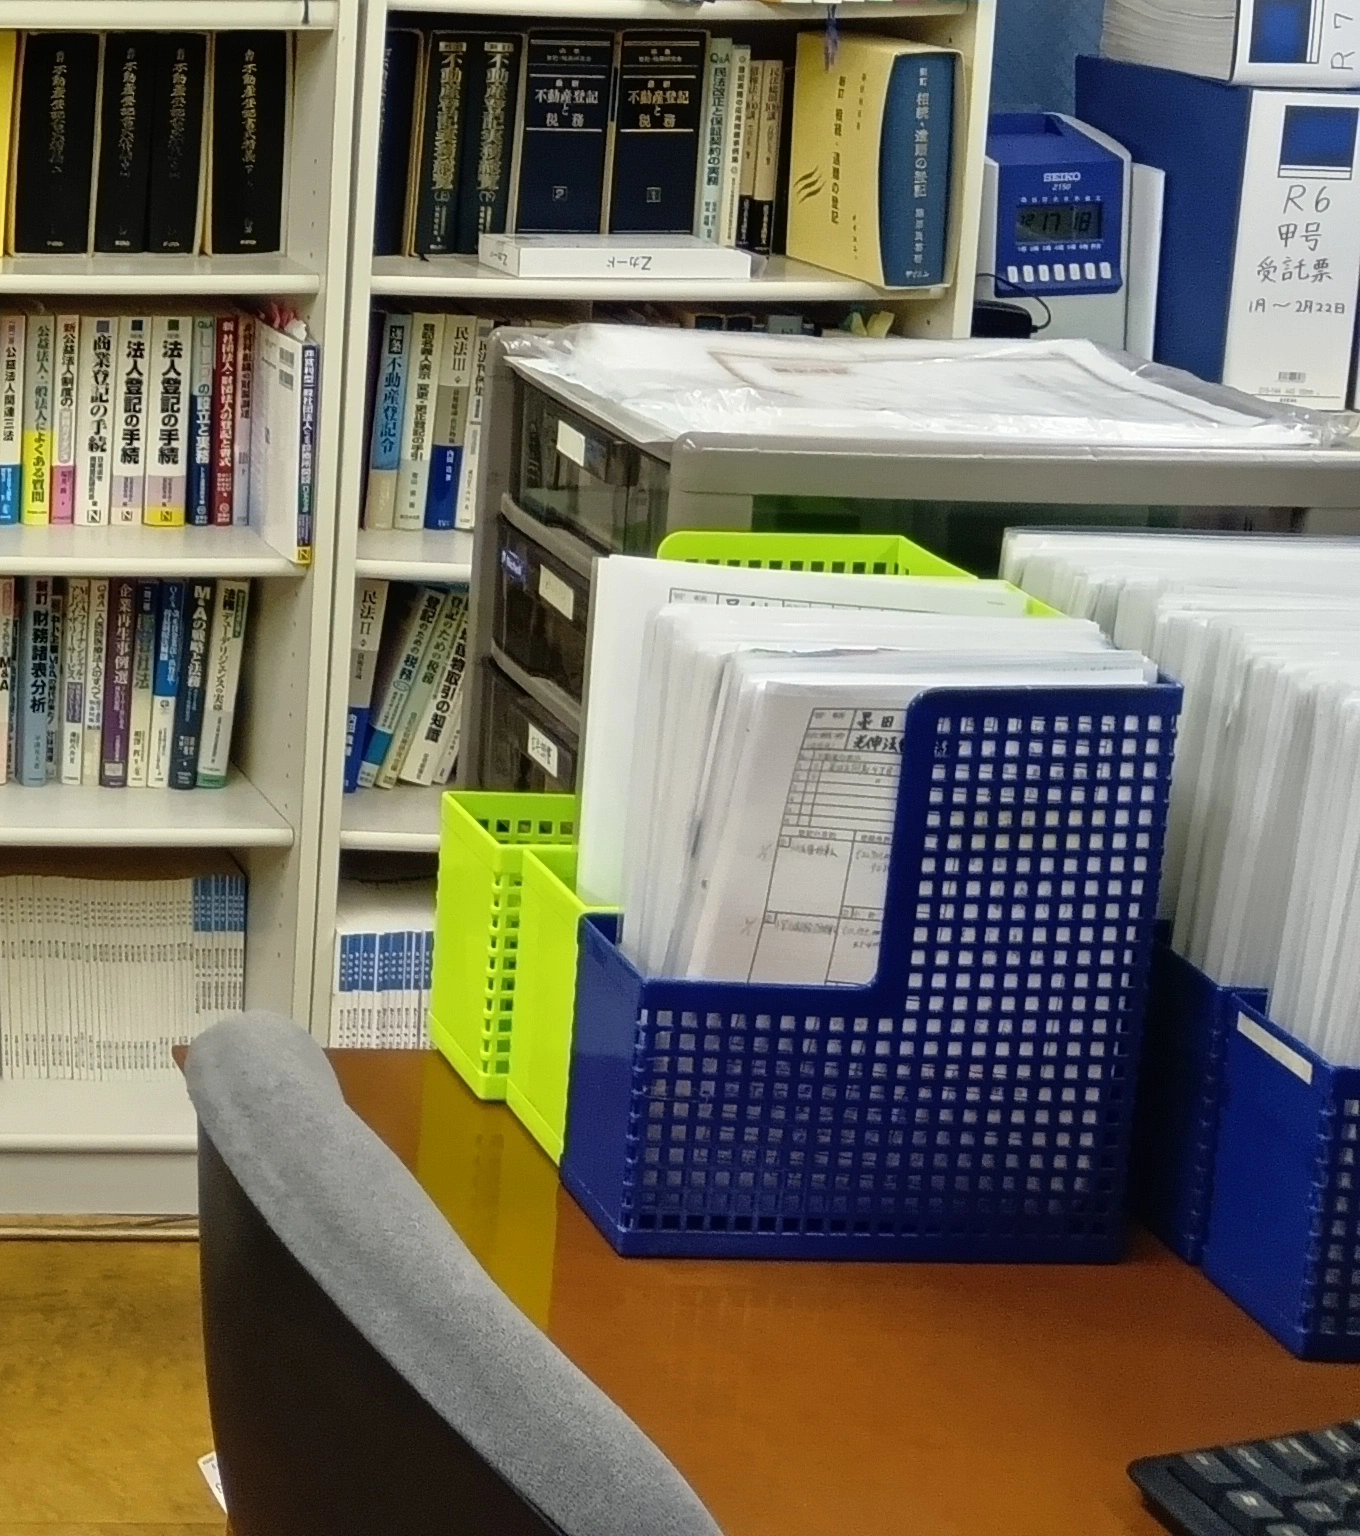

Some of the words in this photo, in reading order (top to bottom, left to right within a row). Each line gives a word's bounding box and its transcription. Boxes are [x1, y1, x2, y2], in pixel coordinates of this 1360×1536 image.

[709, 52, 730, 64] Q&A
[534, 89, 599, 105] 不動産登記
[545, 113, 584, 128] 税務
[627, 89, 690, 105] 不動産登記
[638, 113, 676, 128] 税務
[707, 67, 727, 187] 民法改正と保証契約の実務
[913, 92, 930, 199] 相続・遺贈の登記
[1043, 172, 1081, 182] SEIKO
[1283, 184, 1331, 214] R6
[606, 256, 653, 270] Zカード
[1278, 222, 1322, 252] 甲号
[1256, 256, 1333, 283] 受託票
[2, 346, 17, 442] 公益法人関連三法
[31, 325, 51, 503] 公益法人・一般法人によくある質問
[87, 333, 112, 453] 商業登記の手続
[120, 340, 145, 465] 法人登記の手続
[158, 340, 182, 465] 法人登記の手続
[380, 355, 402, 453] 不動産登記令
[30, 610, 48, 713] 財務諸表分析
[113, 583, 133, 685] 企業再生事例選
